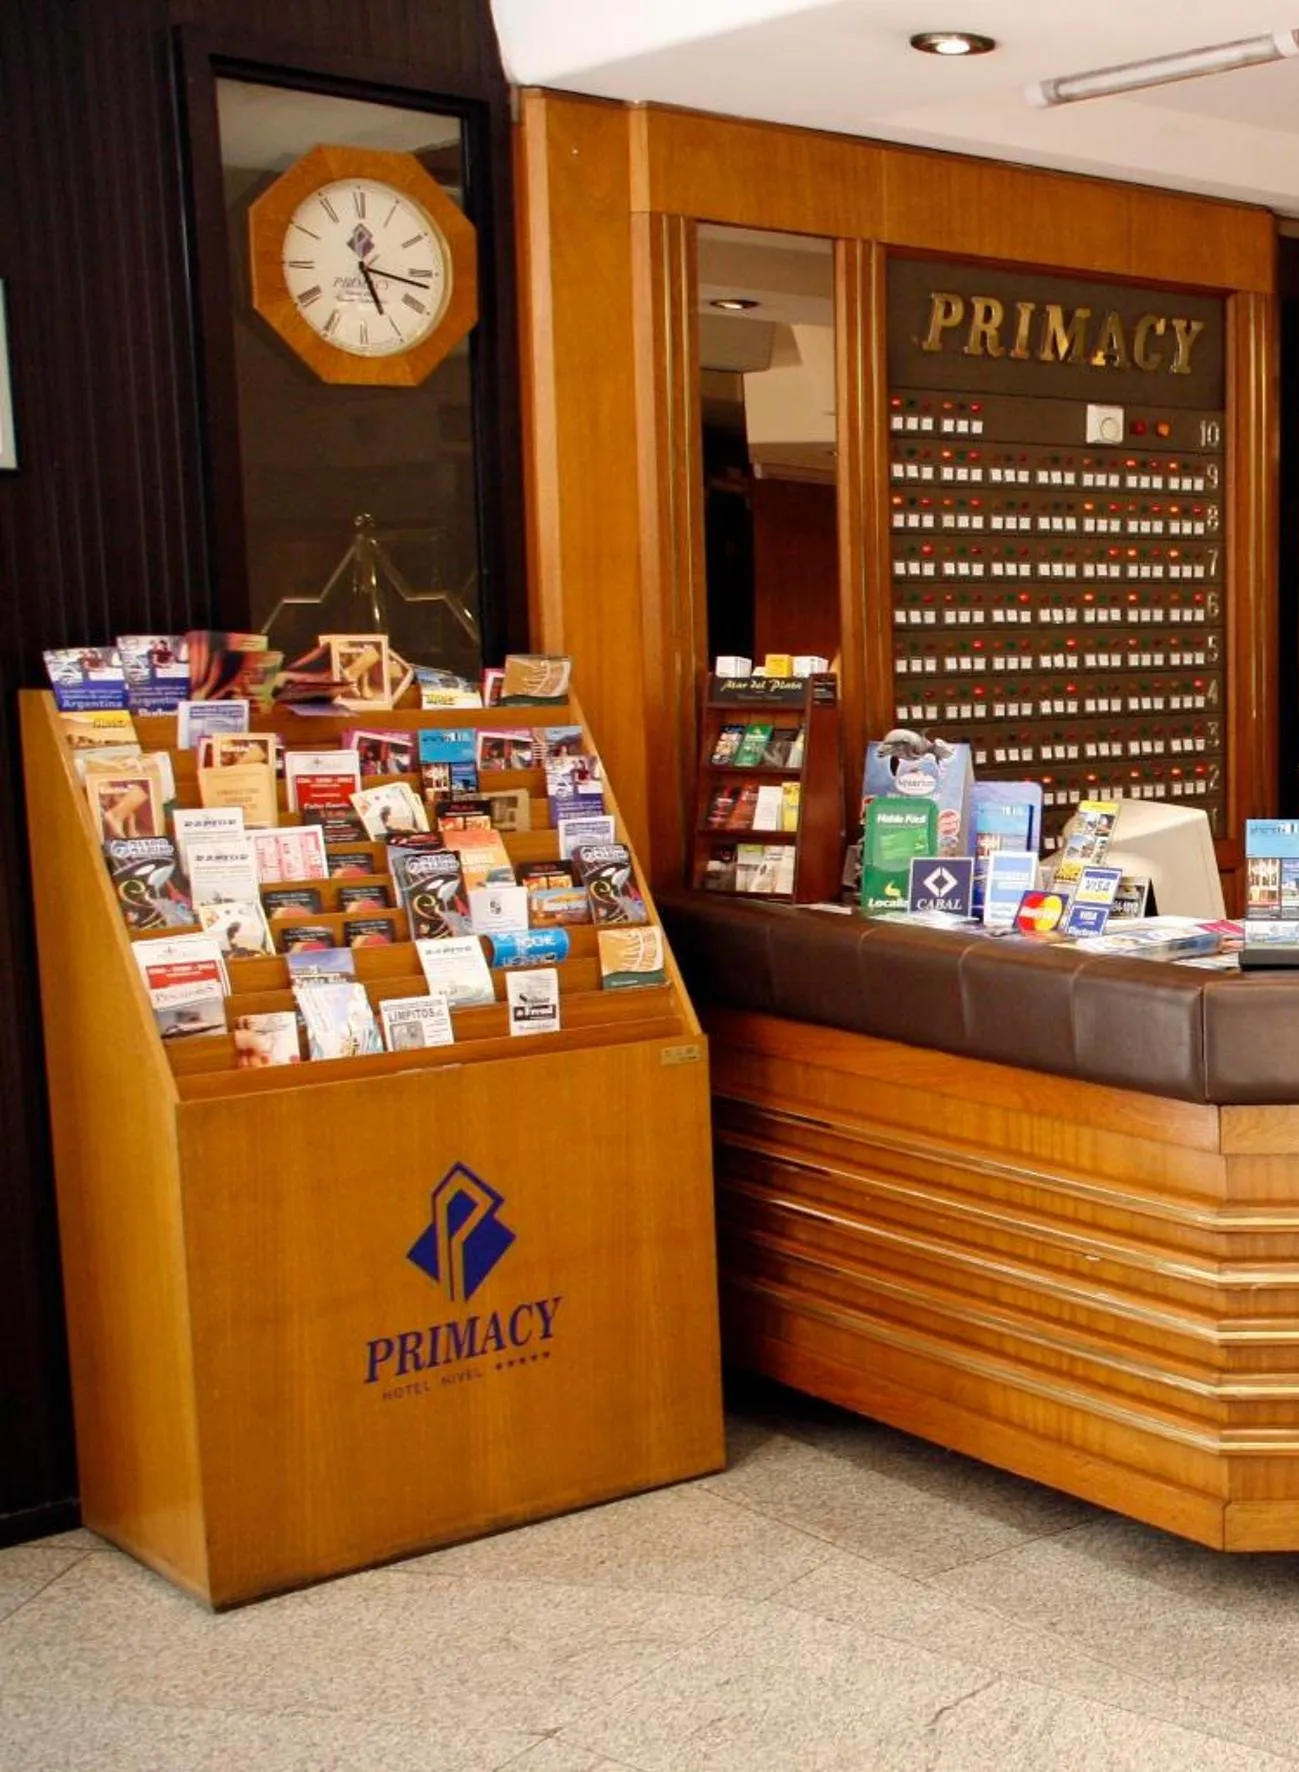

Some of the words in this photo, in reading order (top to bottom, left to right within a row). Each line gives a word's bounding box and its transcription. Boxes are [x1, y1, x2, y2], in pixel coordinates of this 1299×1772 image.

[921, 292, 1204, 375] PRIMACY
[1200, 419, 1220, 448] 10
[1206, 463, 1219, 490] 9
[1206, 504, 1219, 531] 8
[1208, 549, 1218, 577] 7
[1206, 591, 1219, 618] 6
[1207, 635, 1218, 663] 5
[720, 680, 748, 692] Mar
[768, 679, 803, 692] Plata
[1206, 679, 1218, 705] 4
[1208, 764, 1220, 789] 2
[1085, 880, 1111, 892] VISA
[917, 899, 962, 911] CABAL
[363, 1296, 564, 1385] PRIMACY
